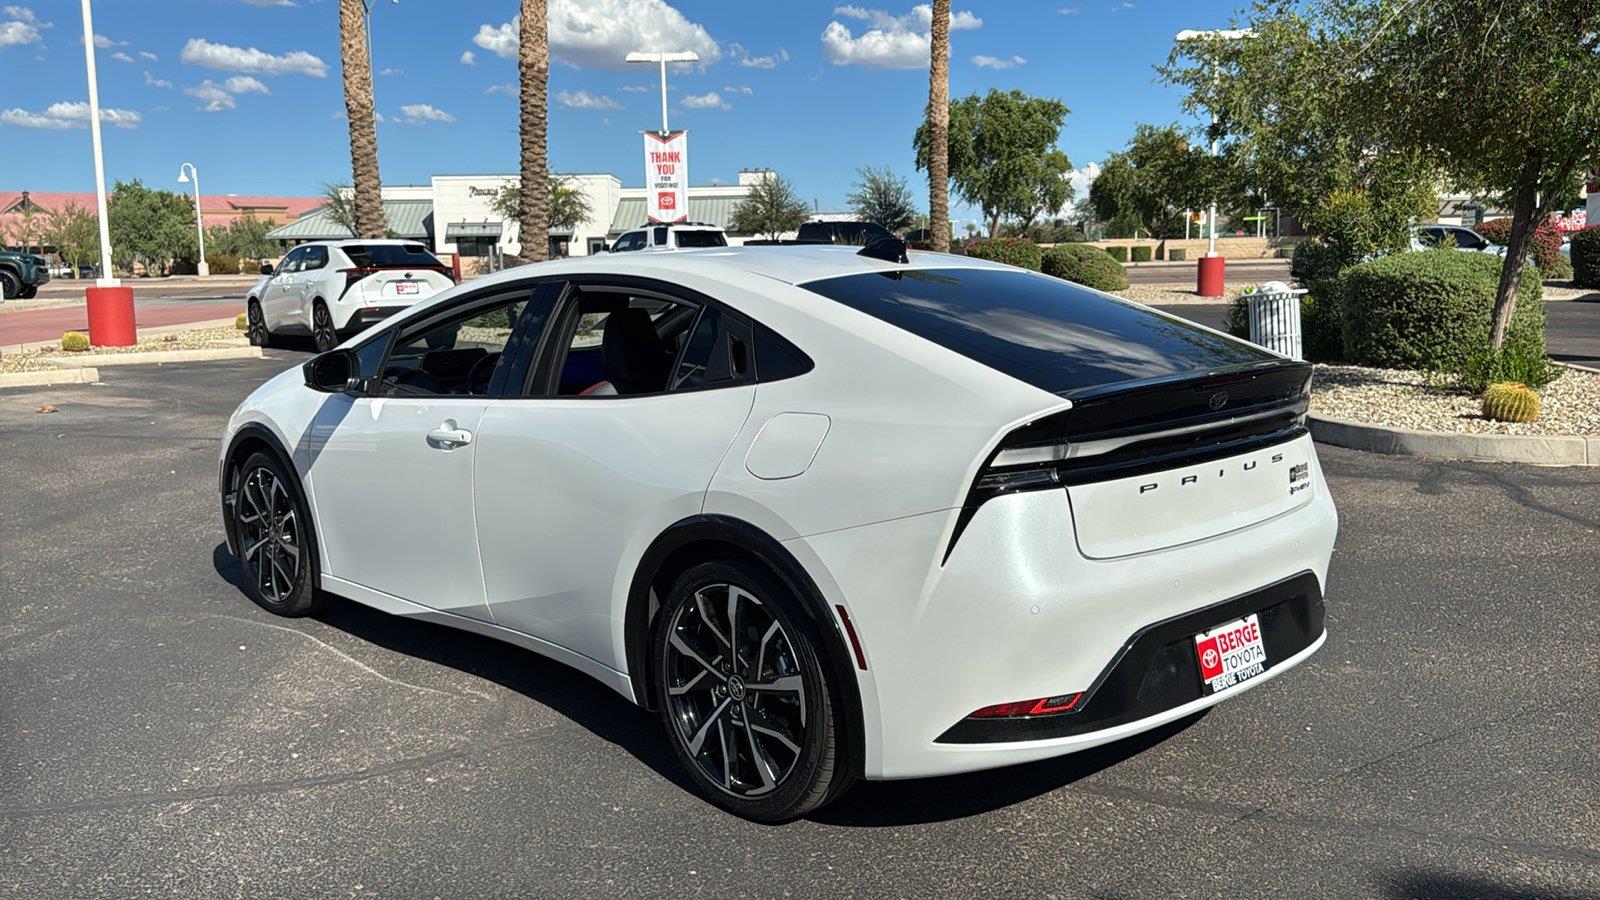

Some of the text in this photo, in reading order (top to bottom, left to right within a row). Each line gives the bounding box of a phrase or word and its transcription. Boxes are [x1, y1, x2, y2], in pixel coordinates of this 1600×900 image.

[650, 152, 680, 163] THANK
[657, 164, 675, 175] YOU
[1139, 453, 1283, 494] PRIUS
[1217, 622, 1259, 654] BERGE
[1223, 645, 1264, 671] TOYOTA
[1211, 662, 1265, 692] BERGE TOYOTA
